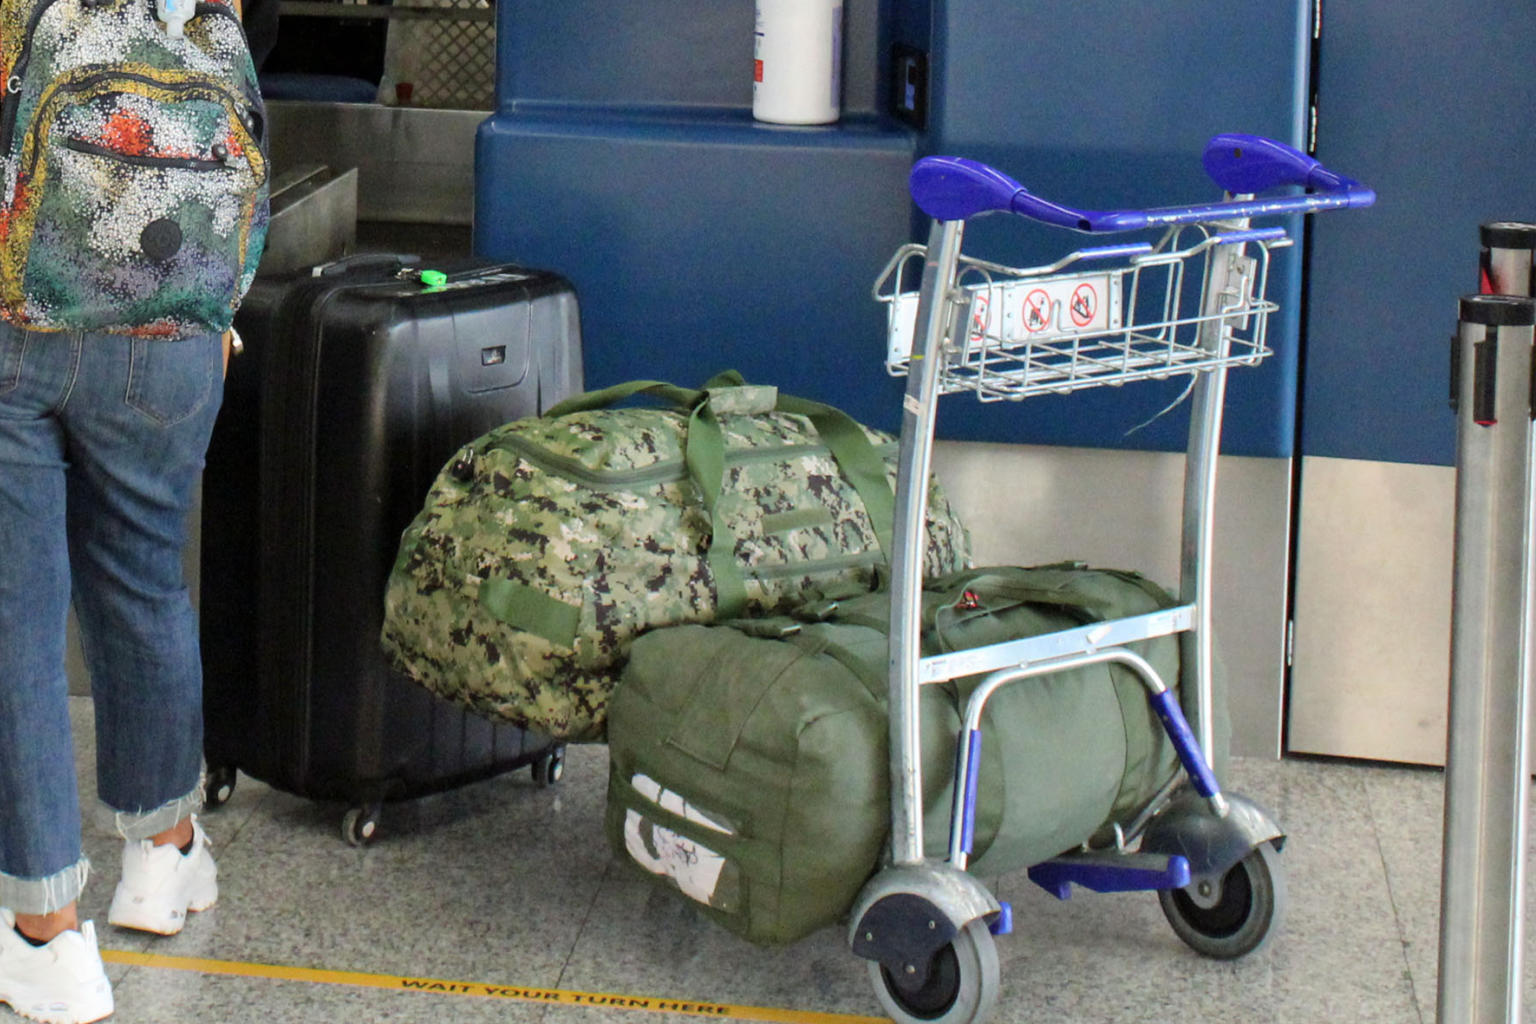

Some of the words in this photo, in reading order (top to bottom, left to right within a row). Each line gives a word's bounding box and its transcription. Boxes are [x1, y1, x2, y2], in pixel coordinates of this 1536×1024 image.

[401, 979, 476, 994] WAIT
[485, 987, 561, 1001] YOUR
[572, 994, 649, 1009] TURN
[659, 1002, 731, 1016] HERE
